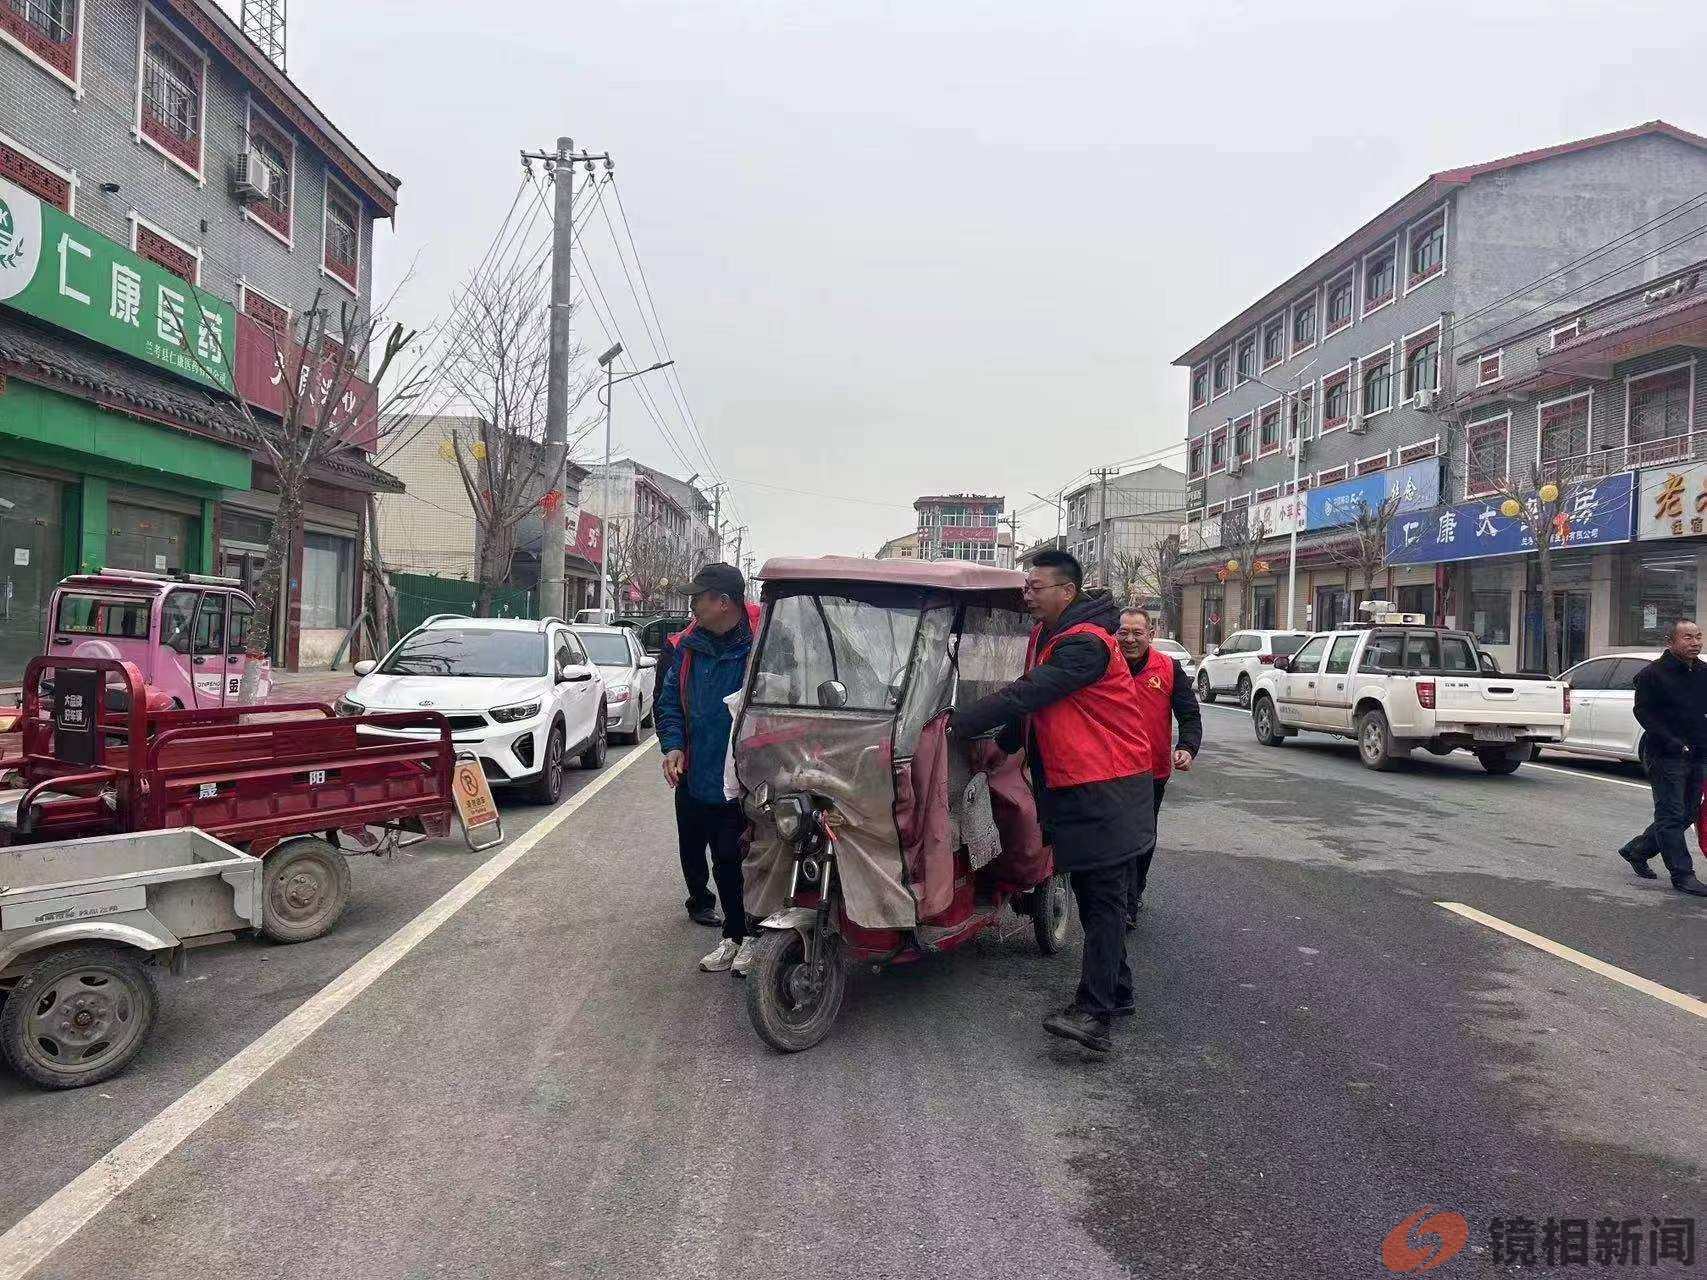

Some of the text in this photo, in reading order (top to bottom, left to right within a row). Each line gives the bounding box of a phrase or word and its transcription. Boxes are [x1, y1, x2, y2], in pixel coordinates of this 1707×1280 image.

[57, 232, 224, 364] 仁康医药
[309, 770, 326, 785] 阳
